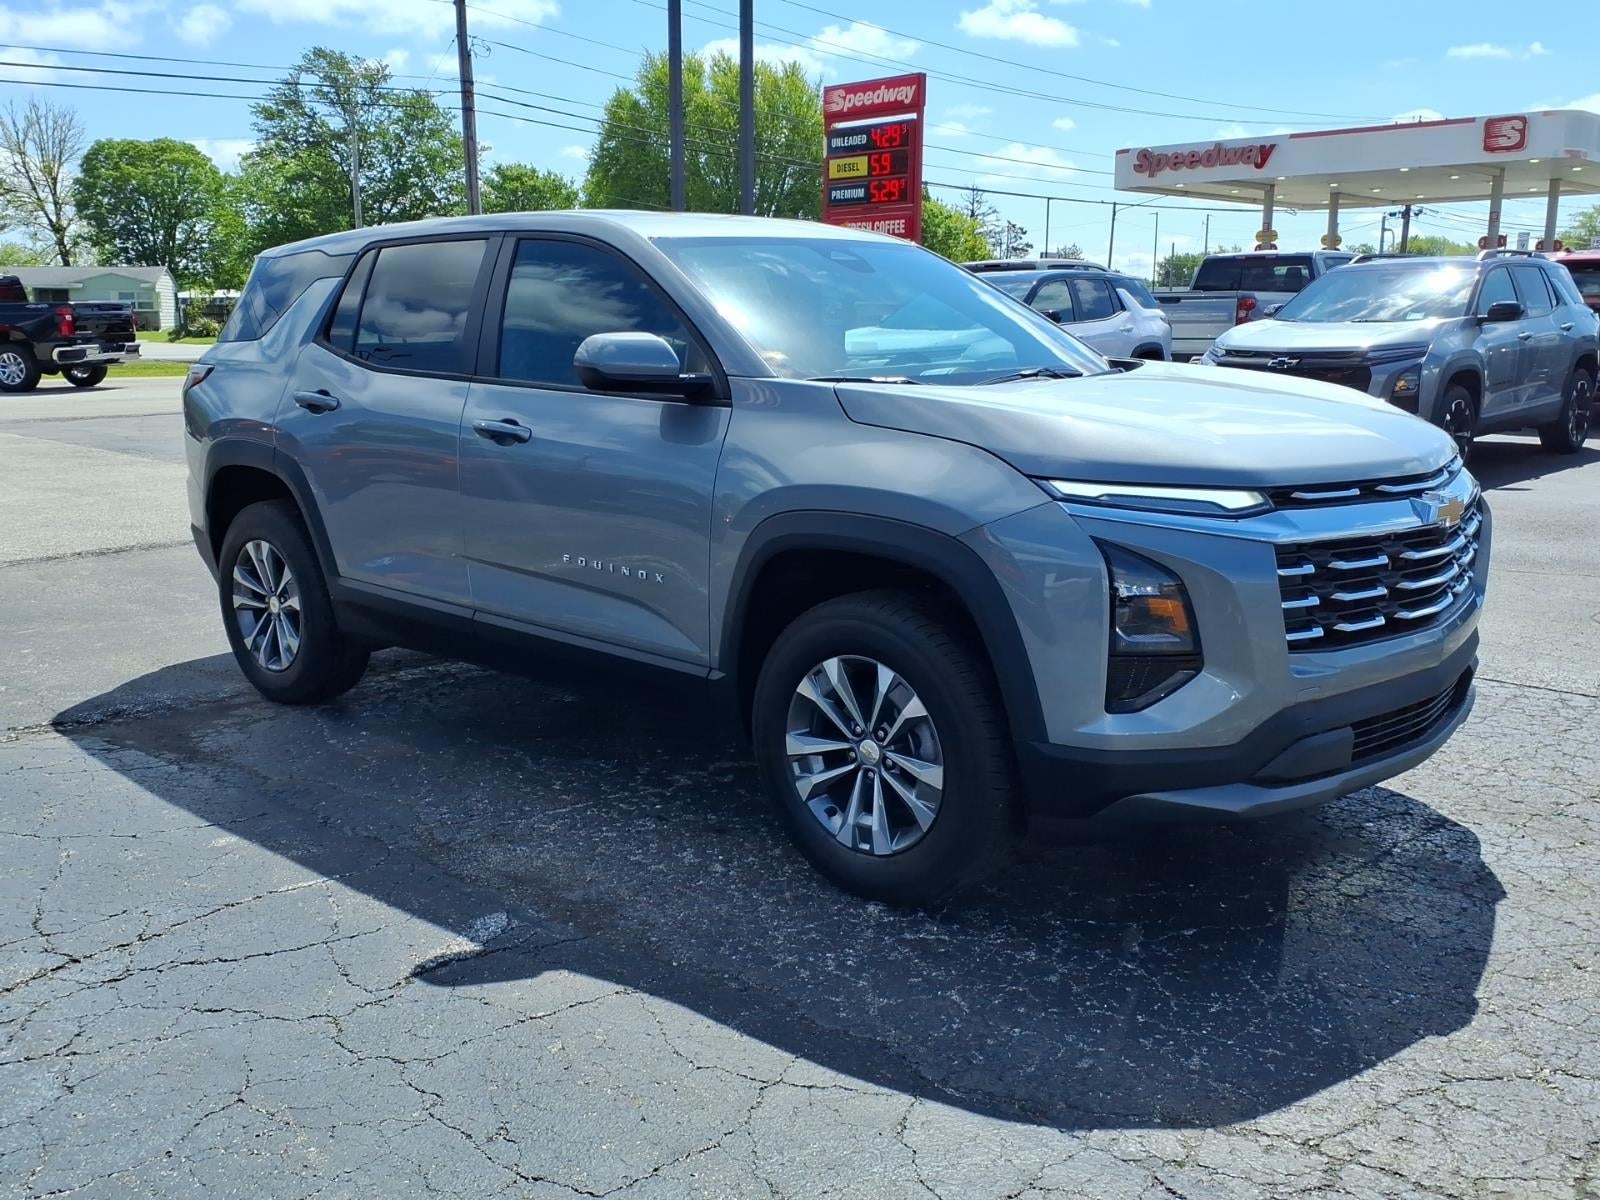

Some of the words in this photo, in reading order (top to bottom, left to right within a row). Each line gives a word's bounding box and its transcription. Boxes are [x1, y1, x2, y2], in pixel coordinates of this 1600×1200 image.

[827, 85, 916, 112] Speedway
[831, 134, 867, 148] UNLEADED
[836, 162, 860, 173] DIESEL
[1133, 143, 1277, 178] Speedway
[831, 188, 865, 200] PREMIUM
[874, 219, 906, 234] COFFEE
[563, 554, 665, 583] EQUINOX
